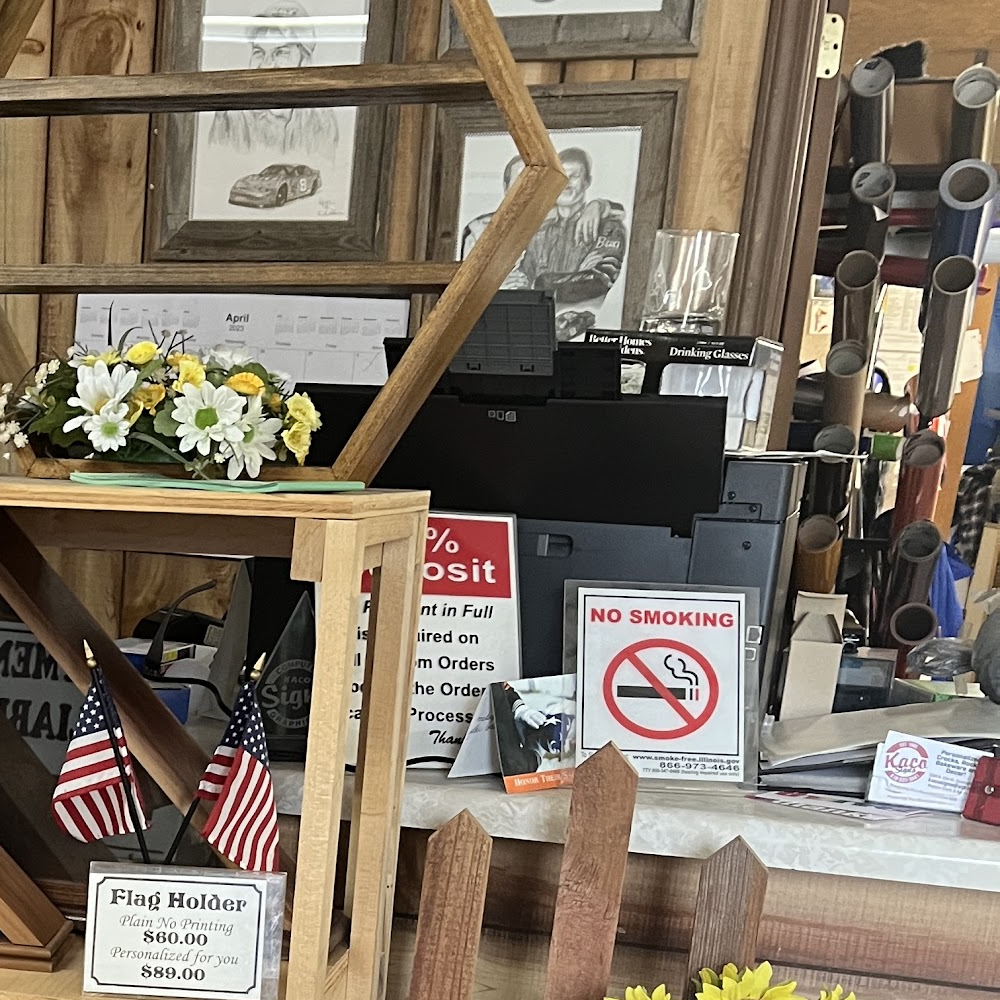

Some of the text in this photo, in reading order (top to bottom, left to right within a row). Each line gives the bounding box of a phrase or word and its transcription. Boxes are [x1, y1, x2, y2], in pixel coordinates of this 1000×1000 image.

[225, 313, 250, 325] April
[669, 347, 750, 360] Drinking Glasses
[423, 557, 497, 584] osit
[442, 603, 457, 617] in
[462, 604, 494, 619] Full
[590, 608, 734, 628] NO SMOKING
[458, 634, 479, 644] on
[438, 656, 495, 671] Orders
[632, 754, 740, 765] www.smoke-free.illinois.gov
[659, 762, 740, 771] 866-973-4646
[885, 752, 927, 769] Kaco
[110, 888, 247, 913] Flag Holder
[119, 914, 234, 937] Plain No Printing
[143, 929, 208, 947] $60.00
[110, 946, 239, 968] Personalized for you
[141, 963, 206, 982] $89.00
